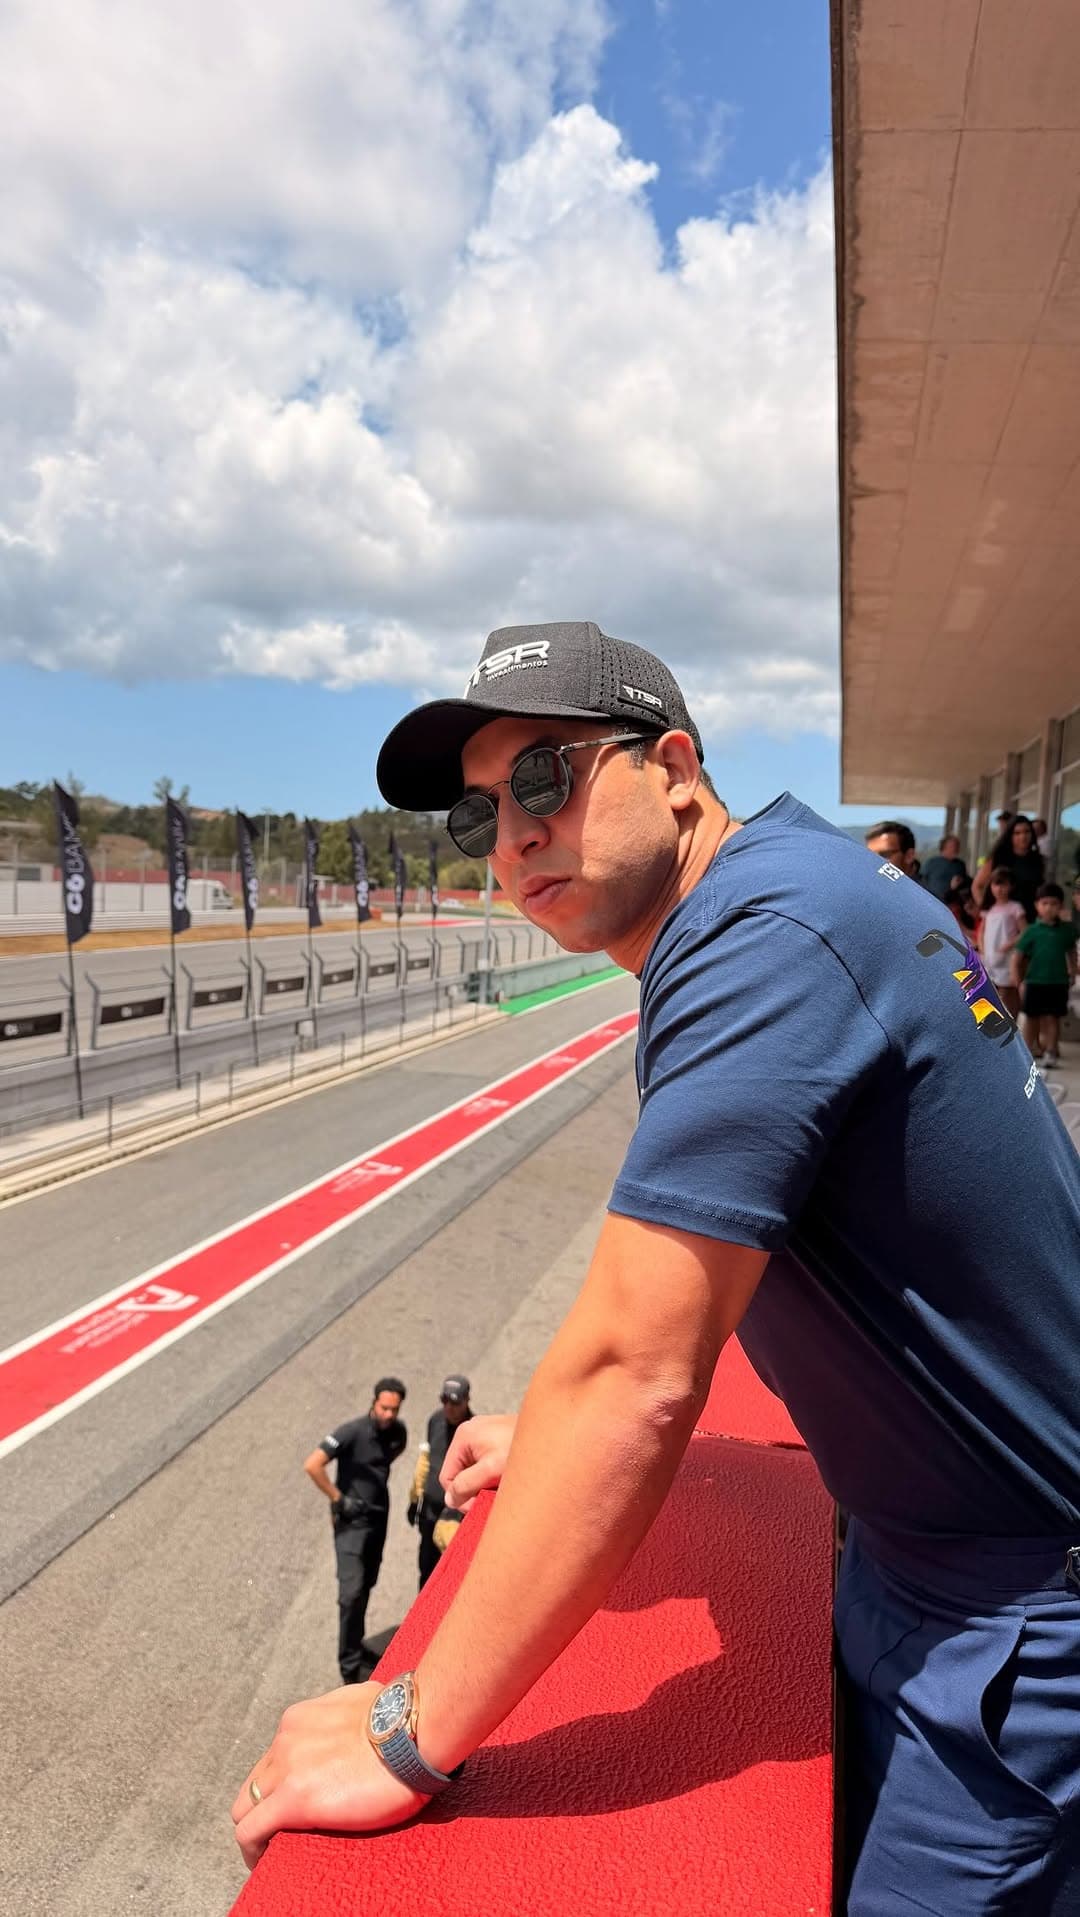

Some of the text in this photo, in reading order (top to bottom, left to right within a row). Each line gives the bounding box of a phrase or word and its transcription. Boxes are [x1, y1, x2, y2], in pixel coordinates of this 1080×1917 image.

[469, 640, 550, 688] TSR
[632, 688, 663, 709] TSR
[65, 873, 86, 915] C6
